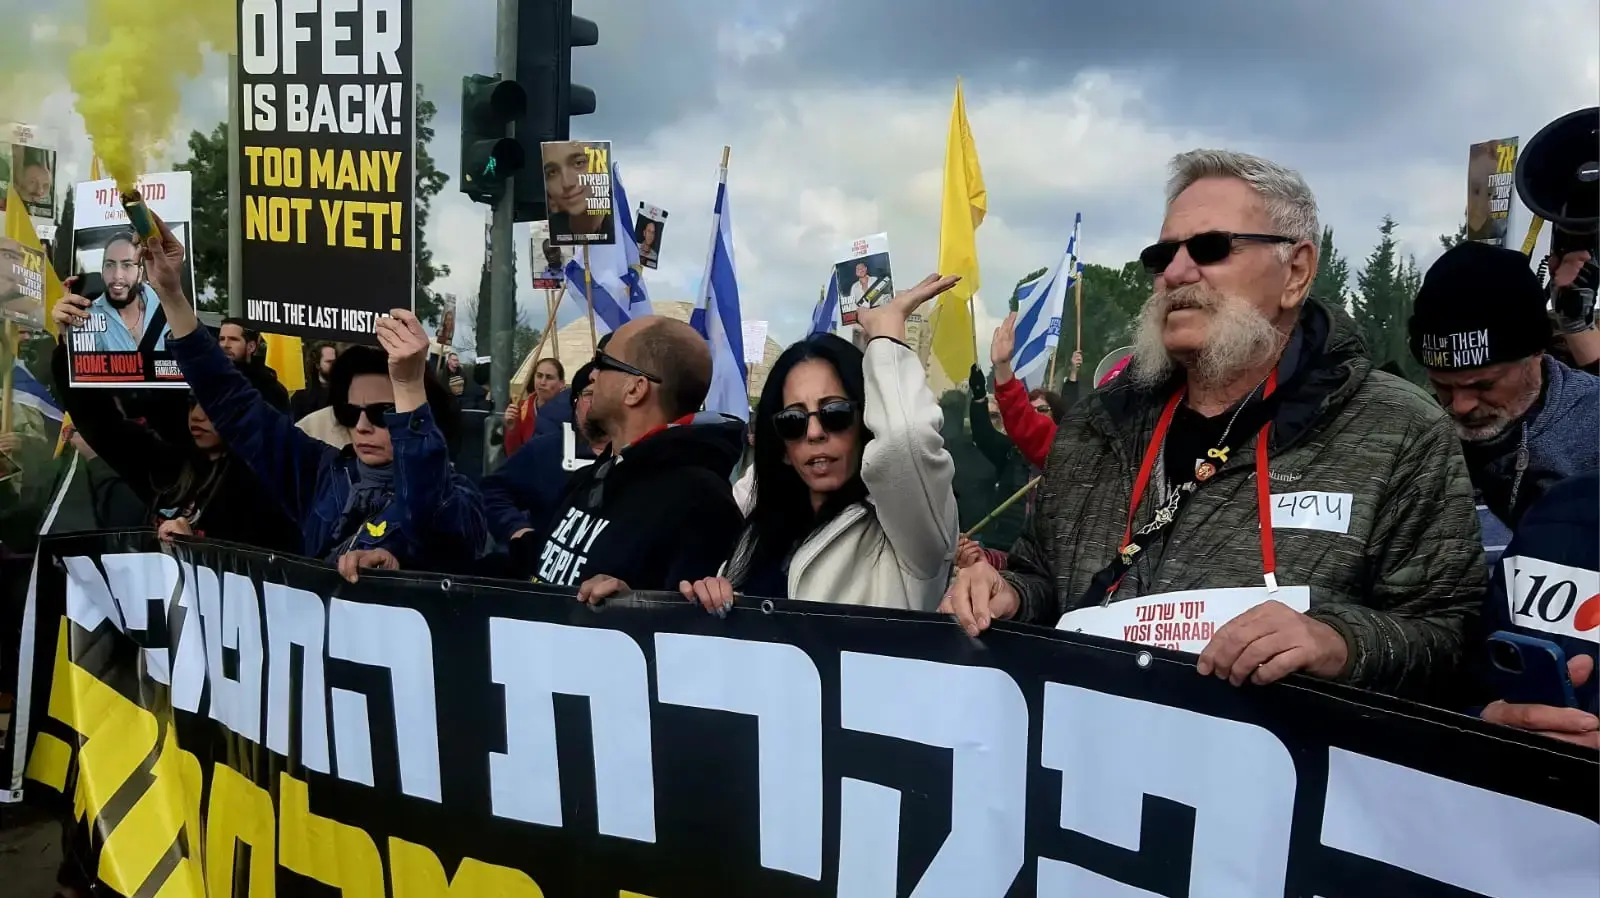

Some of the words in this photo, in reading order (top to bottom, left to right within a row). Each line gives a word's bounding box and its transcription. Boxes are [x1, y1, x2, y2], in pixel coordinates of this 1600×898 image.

[242, 0, 402, 75] OFER
[243, 83, 277, 132] IS
[286, 82, 402, 135] BACK!
[244, 146, 302, 188] TOO
[309, 148, 402, 193] MANY
[584, 146, 609, 174] אל
[1496, 144, 1515, 173] אל
[578, 173, 609, 186] תשאירו
[95, 188, 107, 205] חי
[591, 185, 610, 198] אותי
[246, 195, 313, 244] NOT
[319, 199, 402, 251] YET!
[72, 313, 107, 332] ING
[247, 299, 281, 323] UNTIL
[283, 302, 306, 326] THE
[308, 305, 339, 330] LAST
[341, 309, 394, 334] HOSTA
[72, 332, 96, 352] HIM
[1422, 333, 1440, 351] ALL
[1449, 327, 1489, 351] THEM
[74, 354, 108, 374] HOME
[109, 351, 144, 374] NOW!
[1422, 349, 1452, 368] HOME
[1453, 346, 1490, 368] NOW!
[1277, 494, 1342, 521] 494
[1136, 602, 1176, 623] שרעבי
[1179, 601, 1205, 620] יוסי
[1123, 623, 1152, 642] YOSI
[1154, 621, 1215, 641] SHARABI
